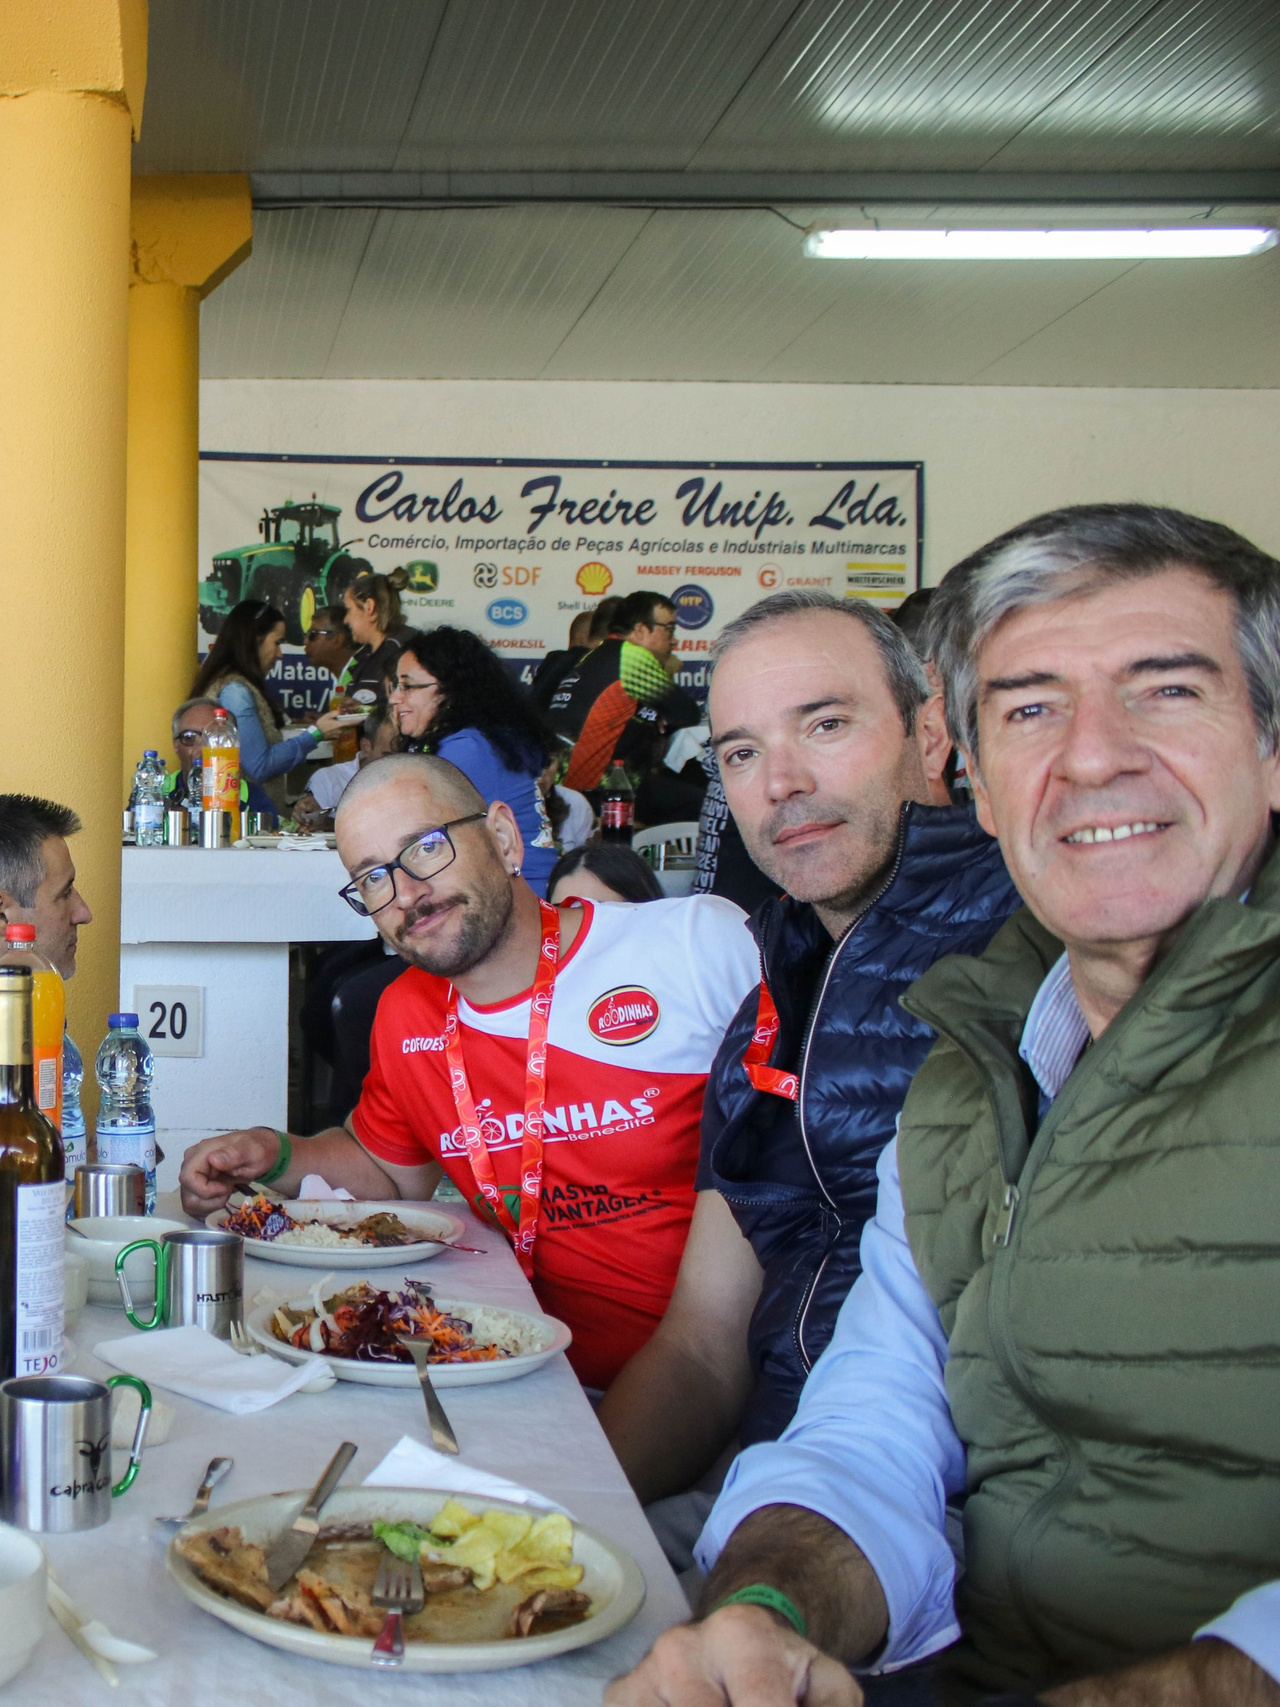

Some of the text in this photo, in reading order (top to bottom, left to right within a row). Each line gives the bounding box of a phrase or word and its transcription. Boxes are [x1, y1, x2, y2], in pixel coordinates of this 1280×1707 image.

[355, 471, 907, 540] Carlos Freire Unip. Lda.
[368, 534, 907, 556] Comércio, Importação de Peças Agrícolas e Industriais Multimarcas
[502, 566, 542, 586] SDF
[637, 565, 741, 576] MASSEY FERGUSON
[787, 577, 832, 587] GRANIT
[419, 598, 455, 607] DEERE
[491, 606, 523, 619] BCS
[558, 601, 580, 610] Shell
[491, 639, 546, 649] MORESIL
[149, 1000, 187, 1040] 20
[568, 1115, 656, 1142] Benedita
[23, 1354, 58, 1375] TEJO
[49, 1480, 94, 1500] capra
